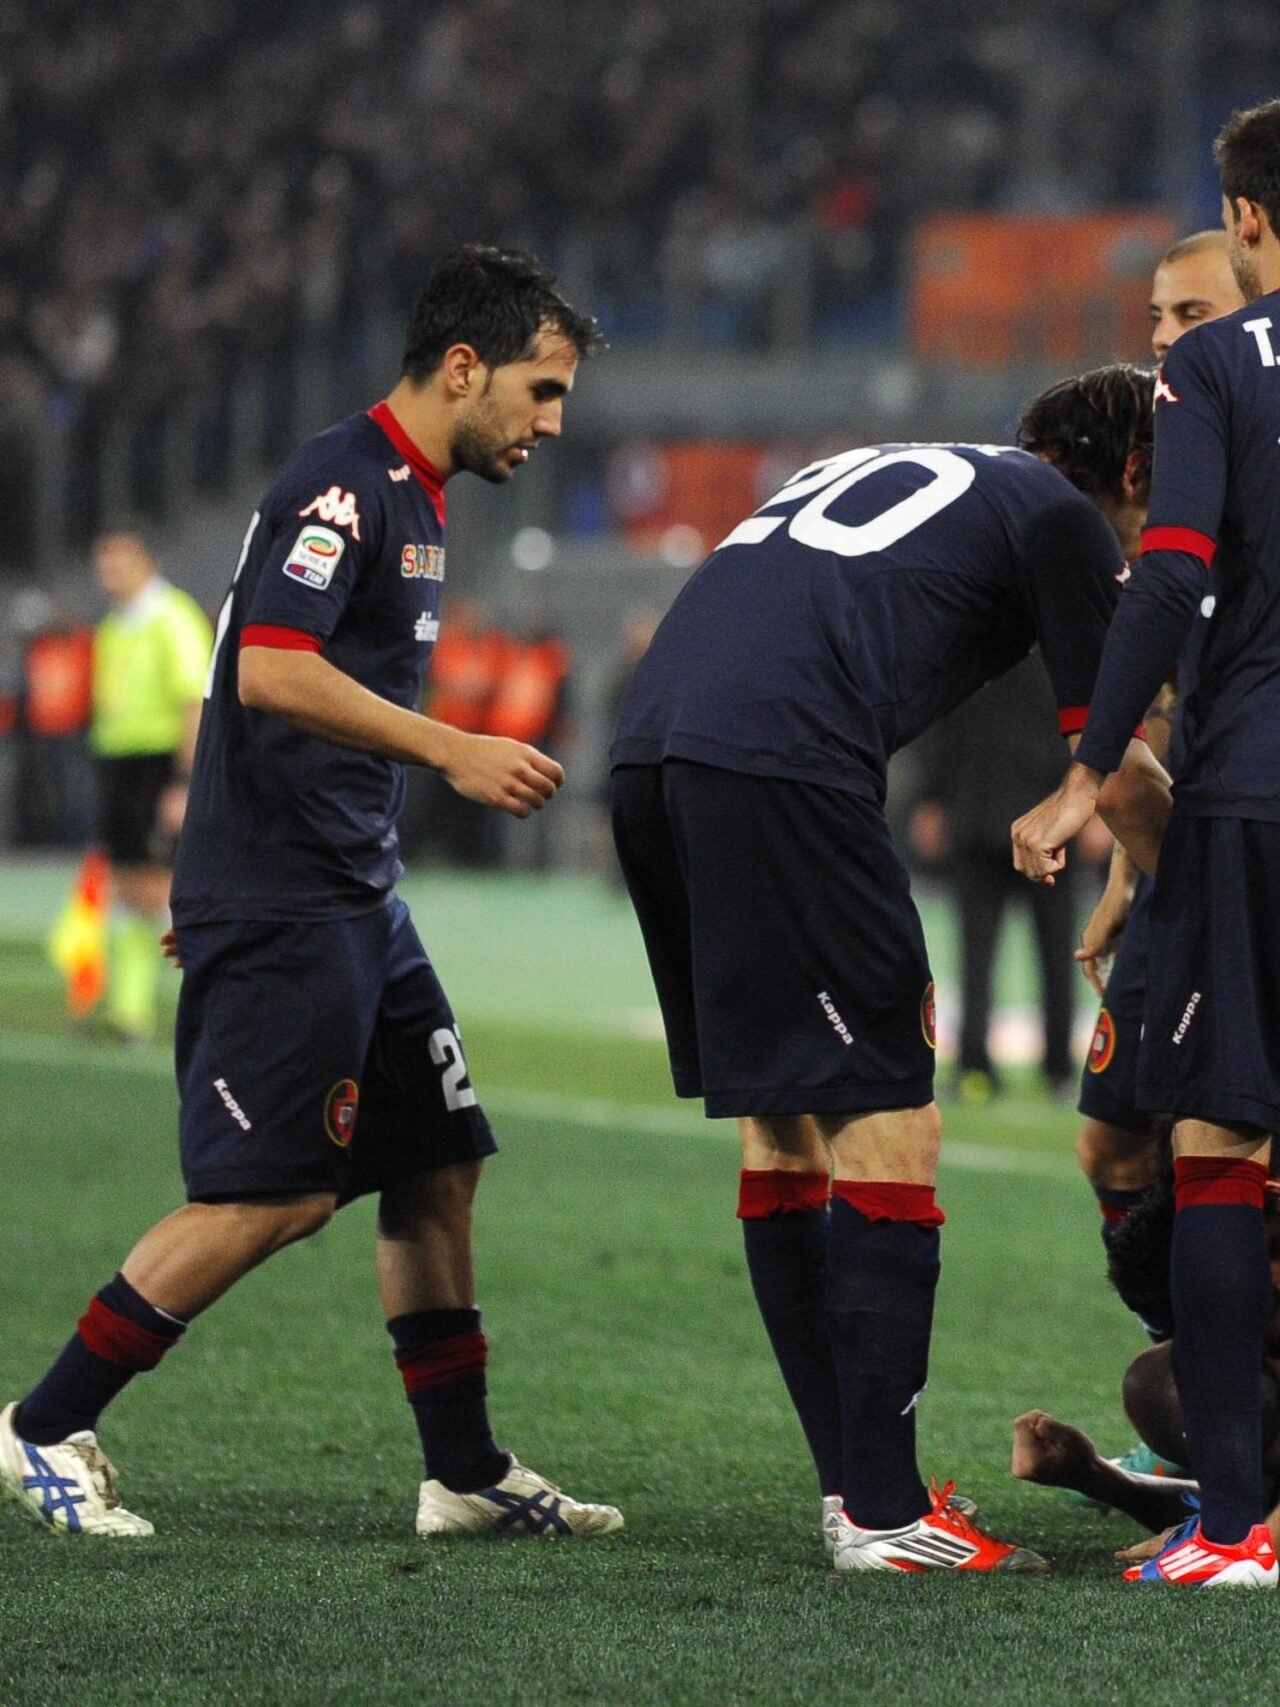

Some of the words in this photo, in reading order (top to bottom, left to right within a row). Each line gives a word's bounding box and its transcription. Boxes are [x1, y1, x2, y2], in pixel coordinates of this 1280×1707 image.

[713, 448, 976, 557] 20
[817, 990, 855, 1046] Kappa
[1172, 991, 1202, 1046] Kappa
[213, 1077, 252, 1131] Kappa
